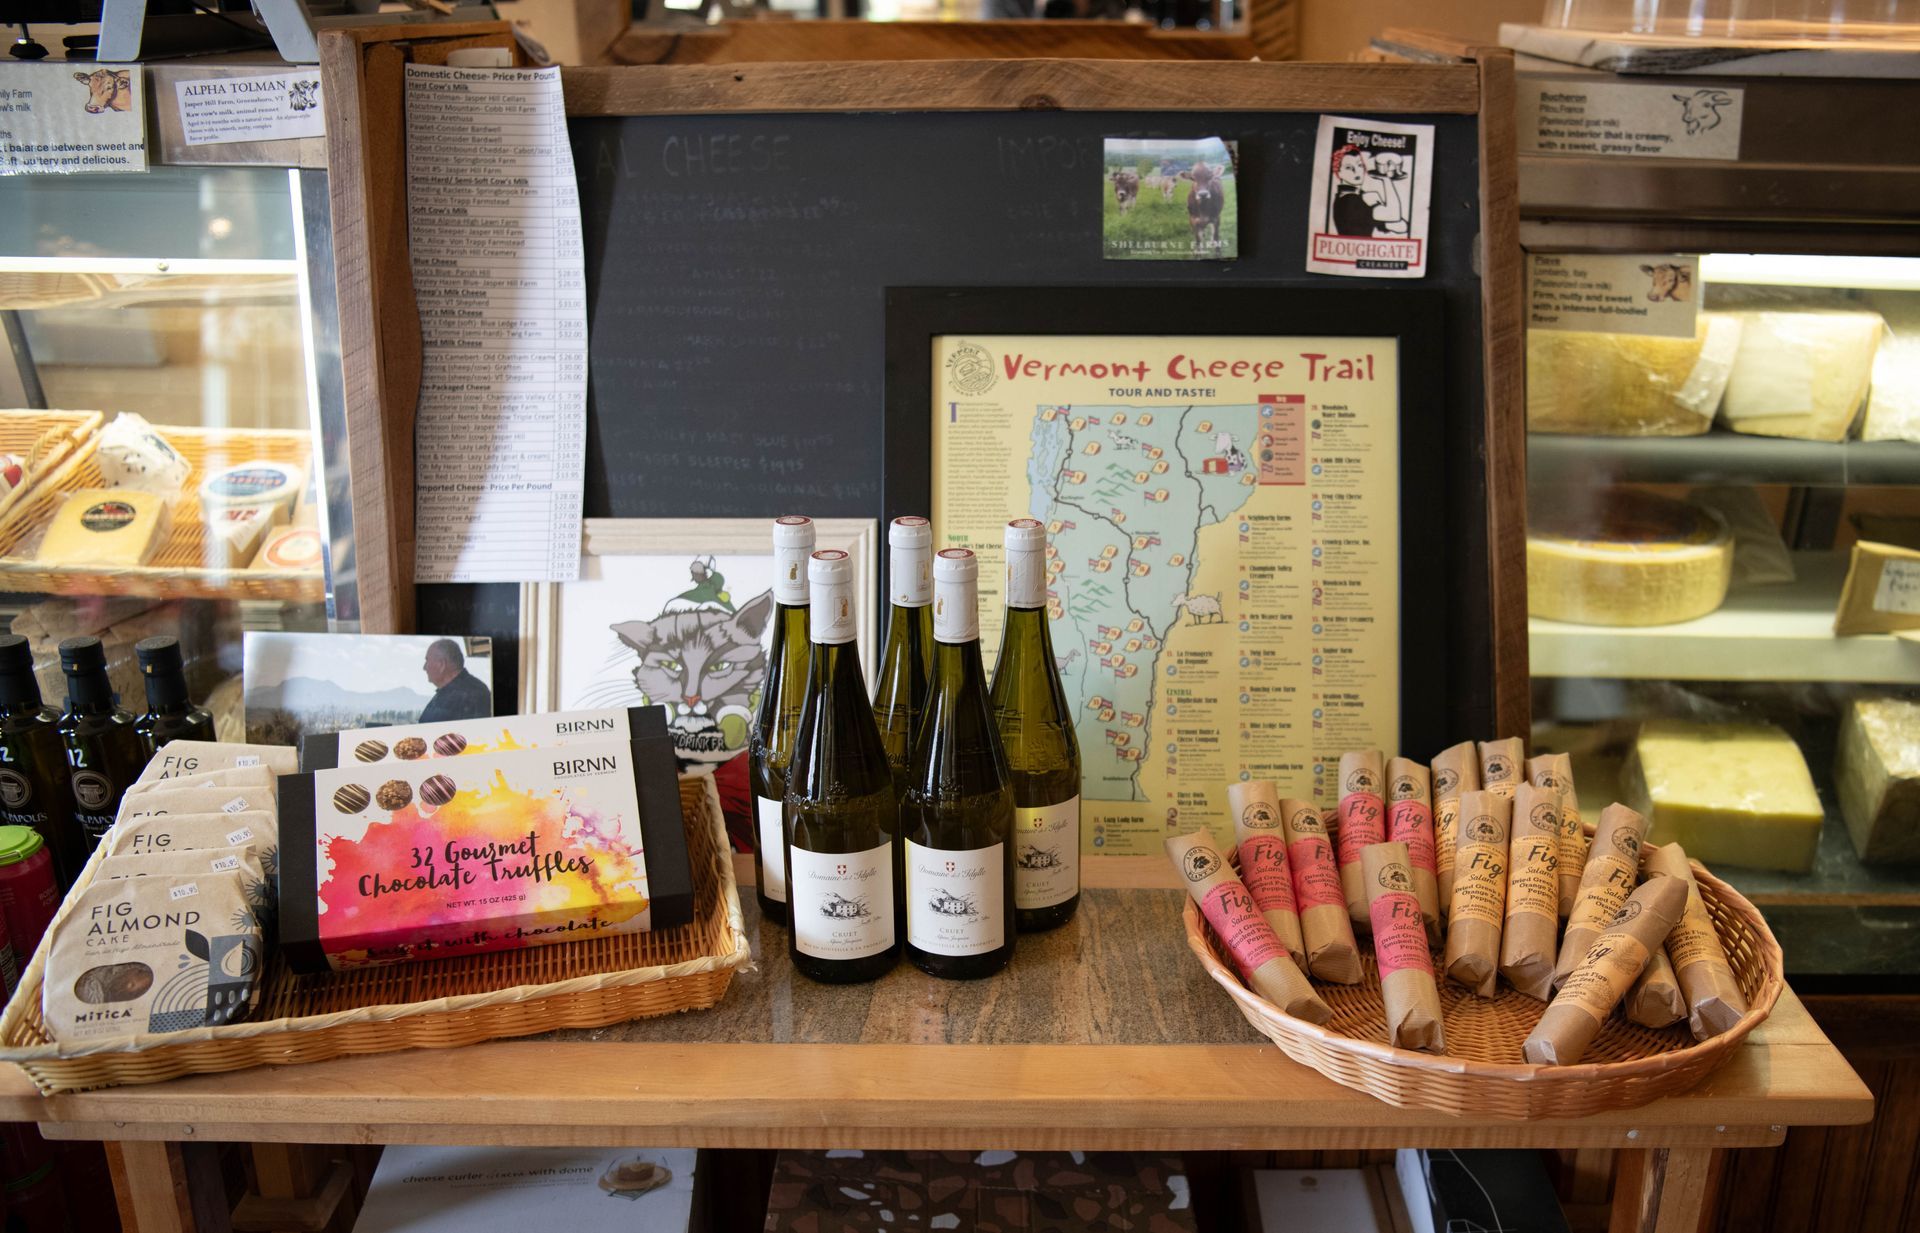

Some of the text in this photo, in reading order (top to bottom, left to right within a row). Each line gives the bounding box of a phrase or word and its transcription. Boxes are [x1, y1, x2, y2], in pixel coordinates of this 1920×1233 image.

[407, 68, 451, 79] Domestic
[493, 72, 516, 81] Price
[518, 72, 532, 80] Per
[184, 80, 287, 97] ALPHA TOLMAN
[97, 142, 126, 151] sweet
[1347, 131, 1407, 148] Enjoy Cheese!
[61, 155, 130, 165] and delicious.
[662, 134, 792, 177] CHEESE
[1111, 239, 1229, 249] SHELBURNE FARMS
[1319, 240, 1415, 259] PLOUGHGATE
[1003, 352, 1375, 383] Vermont Cheese Trail
[1109, 388, 1217, 398] TOUR AND TASTE!
[418, 484, 455, 493] Imported
[527, 482, 552, 491] Pound
[556, 718, 615, 734] BIRNN
[679, 734, 710, 750] DRINK
[68, 748, 87, 768] 12
[163, 756, 198, 771] FIG
[553, 756, 617, 776] BIRNN
[1348, 800, 1378, 822] Fig
[1395, 807, 1424, 829] Fig
[1561, 813, 1579, 833] ig
[133, 834, 171, 849] FIG
[411, 831, 541, 869] 32 Gourmet
[1251, 844, 1286, 867] Fig
[1528, 845, 1559, 871] Fig
[1471, 852, 1504, 878] Fig
[1526, 867, 1554, 879] Salami
[359, 851, 595, 899] Chocolate Truffles
[1469, 873, 1498, 887] Salami
[1462, 890, 1490, 899] Orange
[1519, 882, 1547, 892] Orange
[446, 893, 527, 909] NET WT. 15 OZ (425 g)
[1219, 890, 1253, 914] Fig
[91, 902, 132, 920] FIG
[1230, 911, 1259, 929] Salami
[1391, 901, 1422, 927] Fig
[87, 911, 201, 937] ALMOND
[444, 916, 613, 949] with chocolate
[86, 934, 129, 948] CAKE
